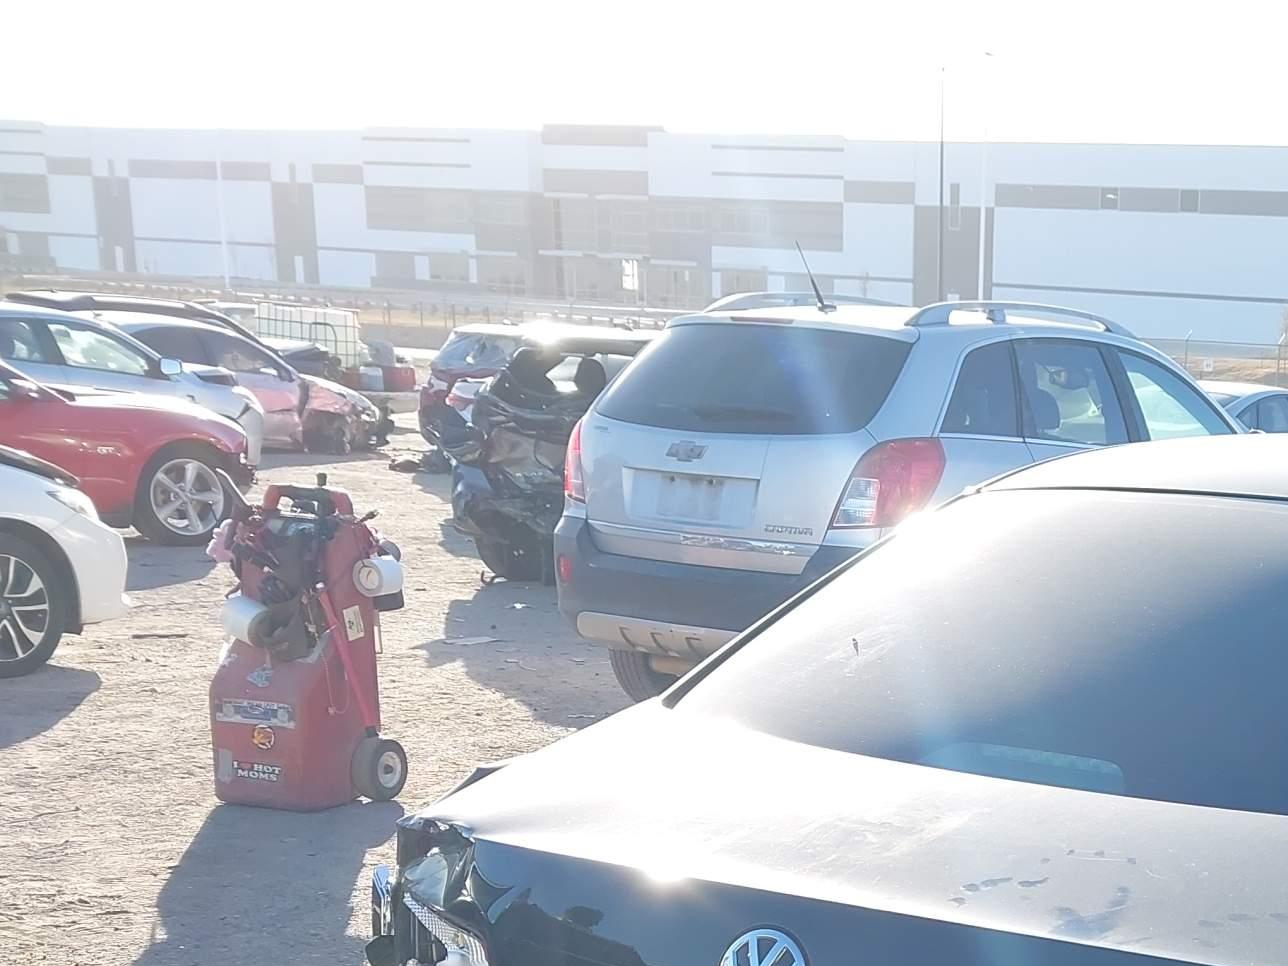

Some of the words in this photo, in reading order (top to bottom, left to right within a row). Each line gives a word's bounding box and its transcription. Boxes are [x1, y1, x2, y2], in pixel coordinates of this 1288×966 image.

[233, 761, 239, 769] I
[253, 763, 282, 776] HOT
[237, 769, 278, 782] MOMS
